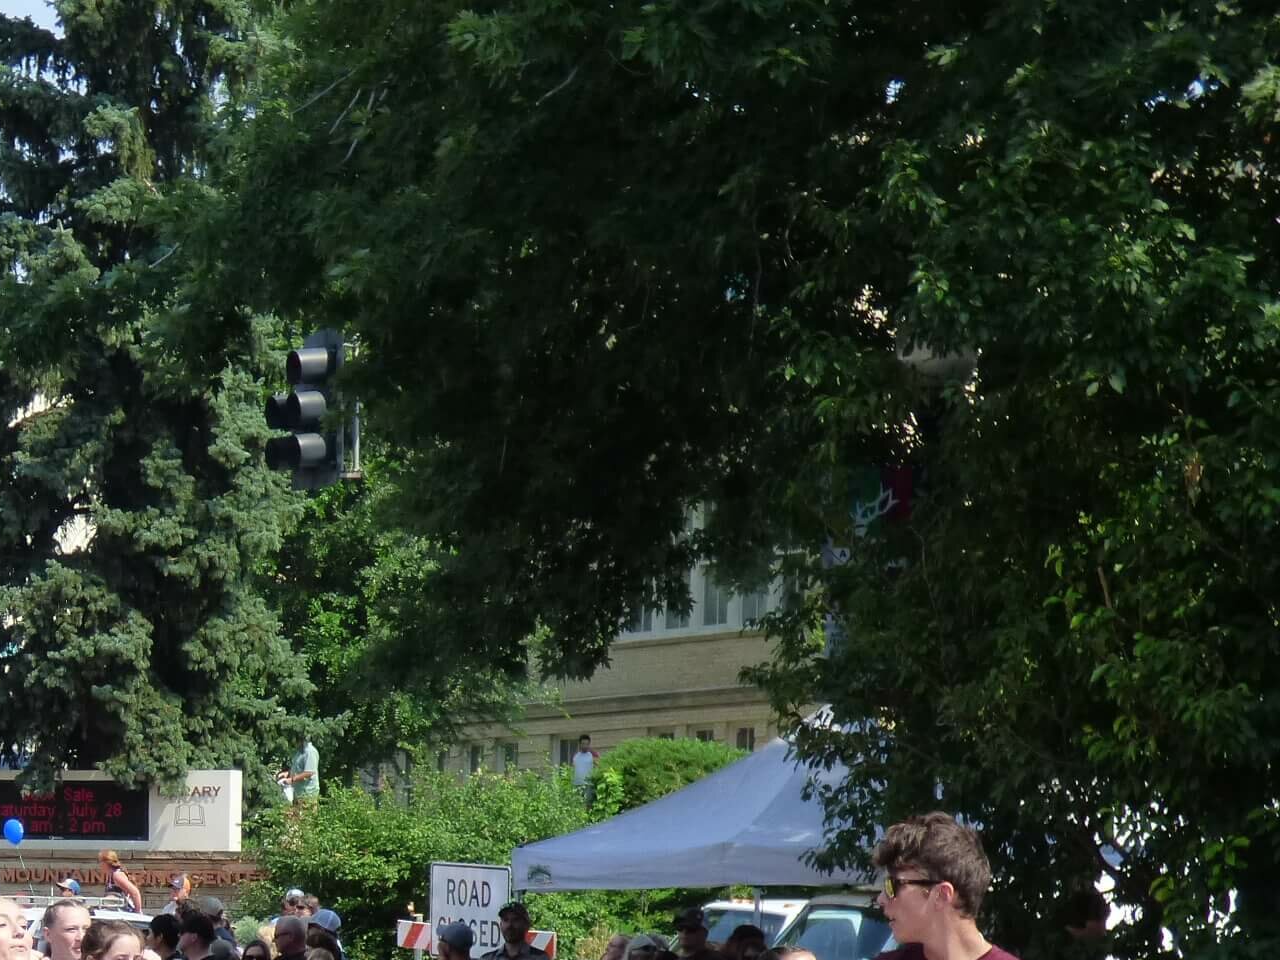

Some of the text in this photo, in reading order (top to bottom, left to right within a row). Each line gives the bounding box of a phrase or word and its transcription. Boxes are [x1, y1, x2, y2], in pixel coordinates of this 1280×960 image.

[64, 787, 95, 802] Sale
[67, 802, 99, 819] July
[104, 802, 123, 818] 28
[31, 821, 54, 834] am
[82, 821, 107, 836] pm
[0, 867, 180, 885] MOUNTAINRIN
[446, 878, 492, 908] ROAD
[437, 916, 501, 948] CSED
